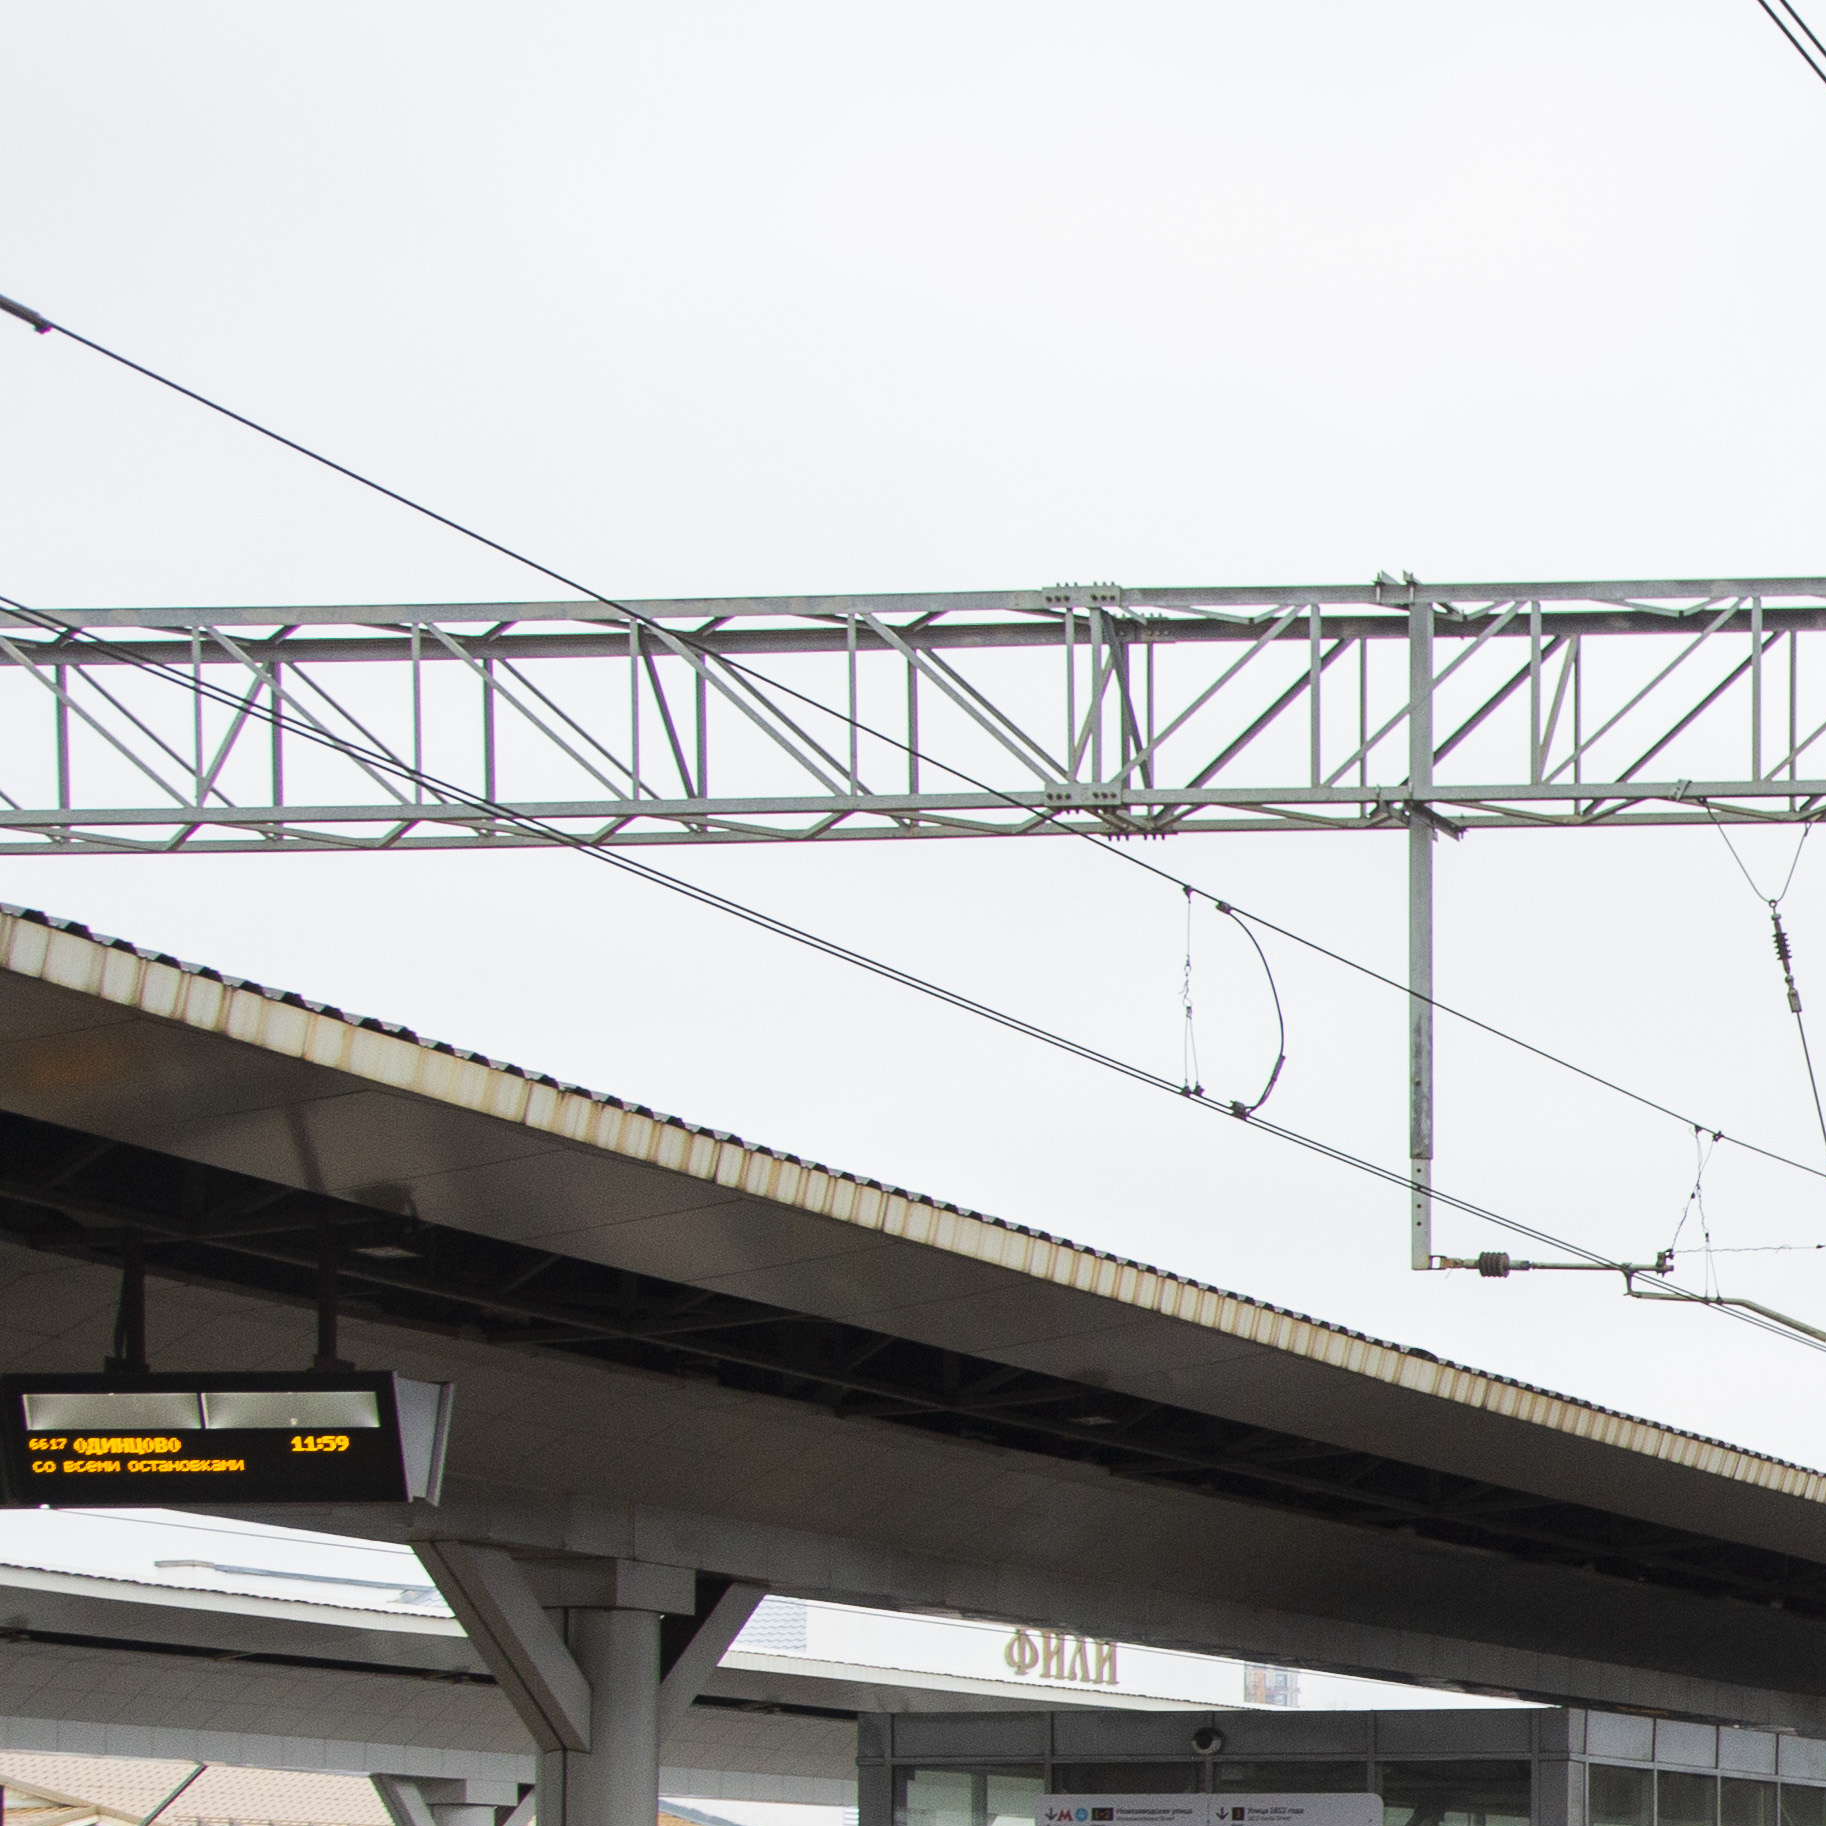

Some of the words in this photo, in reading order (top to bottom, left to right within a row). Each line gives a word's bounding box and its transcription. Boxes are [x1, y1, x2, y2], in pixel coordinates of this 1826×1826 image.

[73, 1437, 182, 1455] ОДИНЦОВО
[290, 1435, 350, 1452] 11:59
[31, 1460, 57, 1473] со
[62, 1460, 121, 1473] всеми
[127, 1459, 245, 1473] остановками
